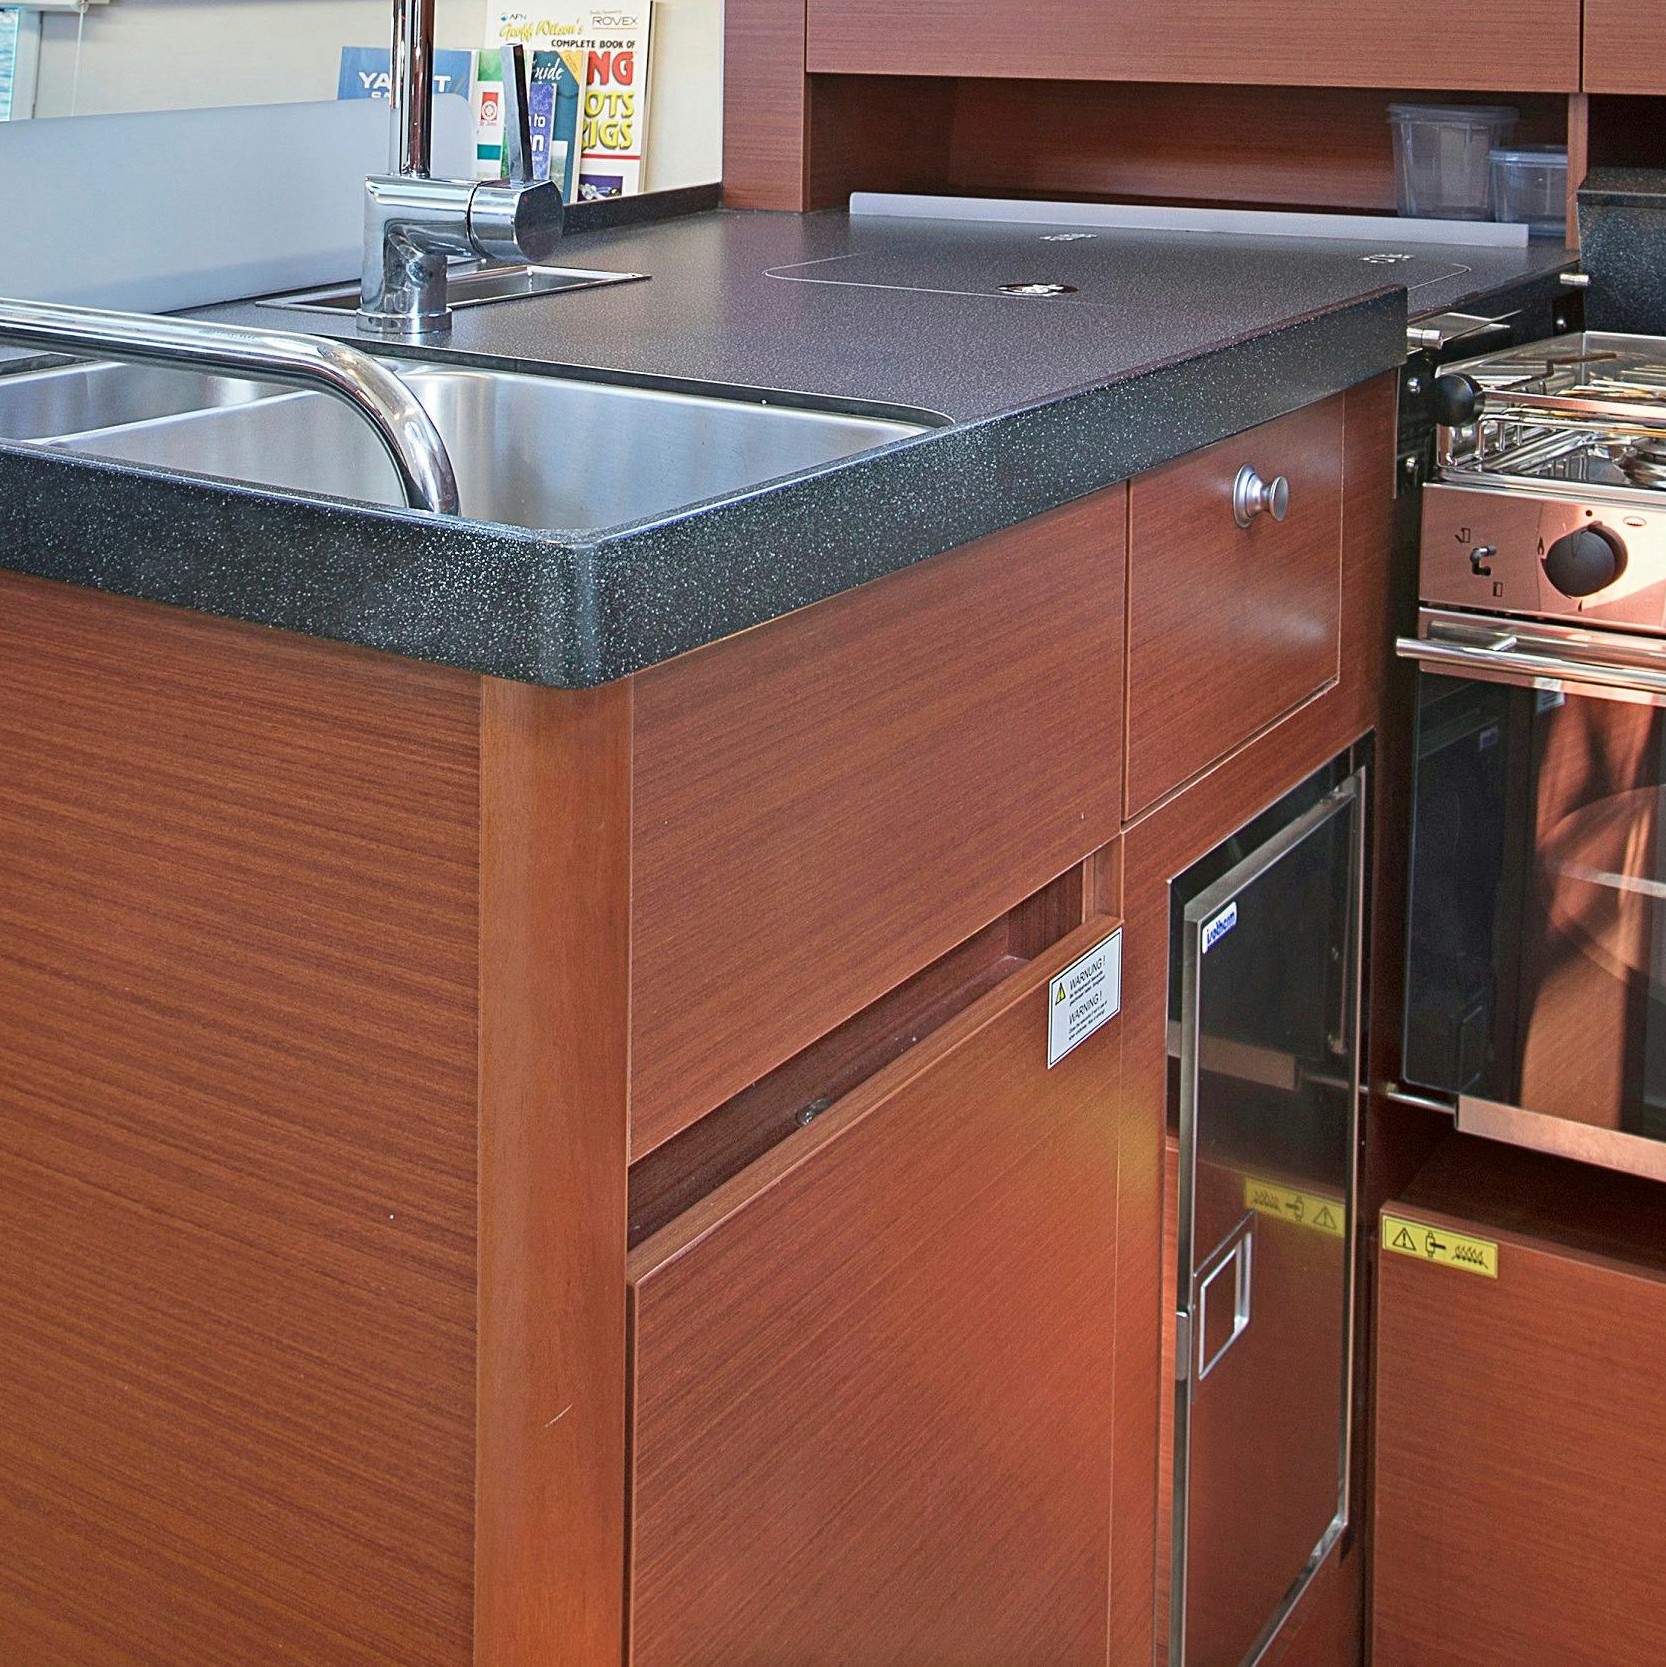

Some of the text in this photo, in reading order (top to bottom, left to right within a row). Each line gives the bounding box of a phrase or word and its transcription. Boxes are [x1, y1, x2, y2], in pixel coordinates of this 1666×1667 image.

[592, 16, 638, 26] ROVEX
[551, 39, 635, 48] COMPLETE BOOK OF
[533, 57, 564, 80] uide
[359, 72, 451, 92] YAT
[1069, 958, 1102, 991] WARNUNG
[1069, 993, 1099, 1025] WARNING
